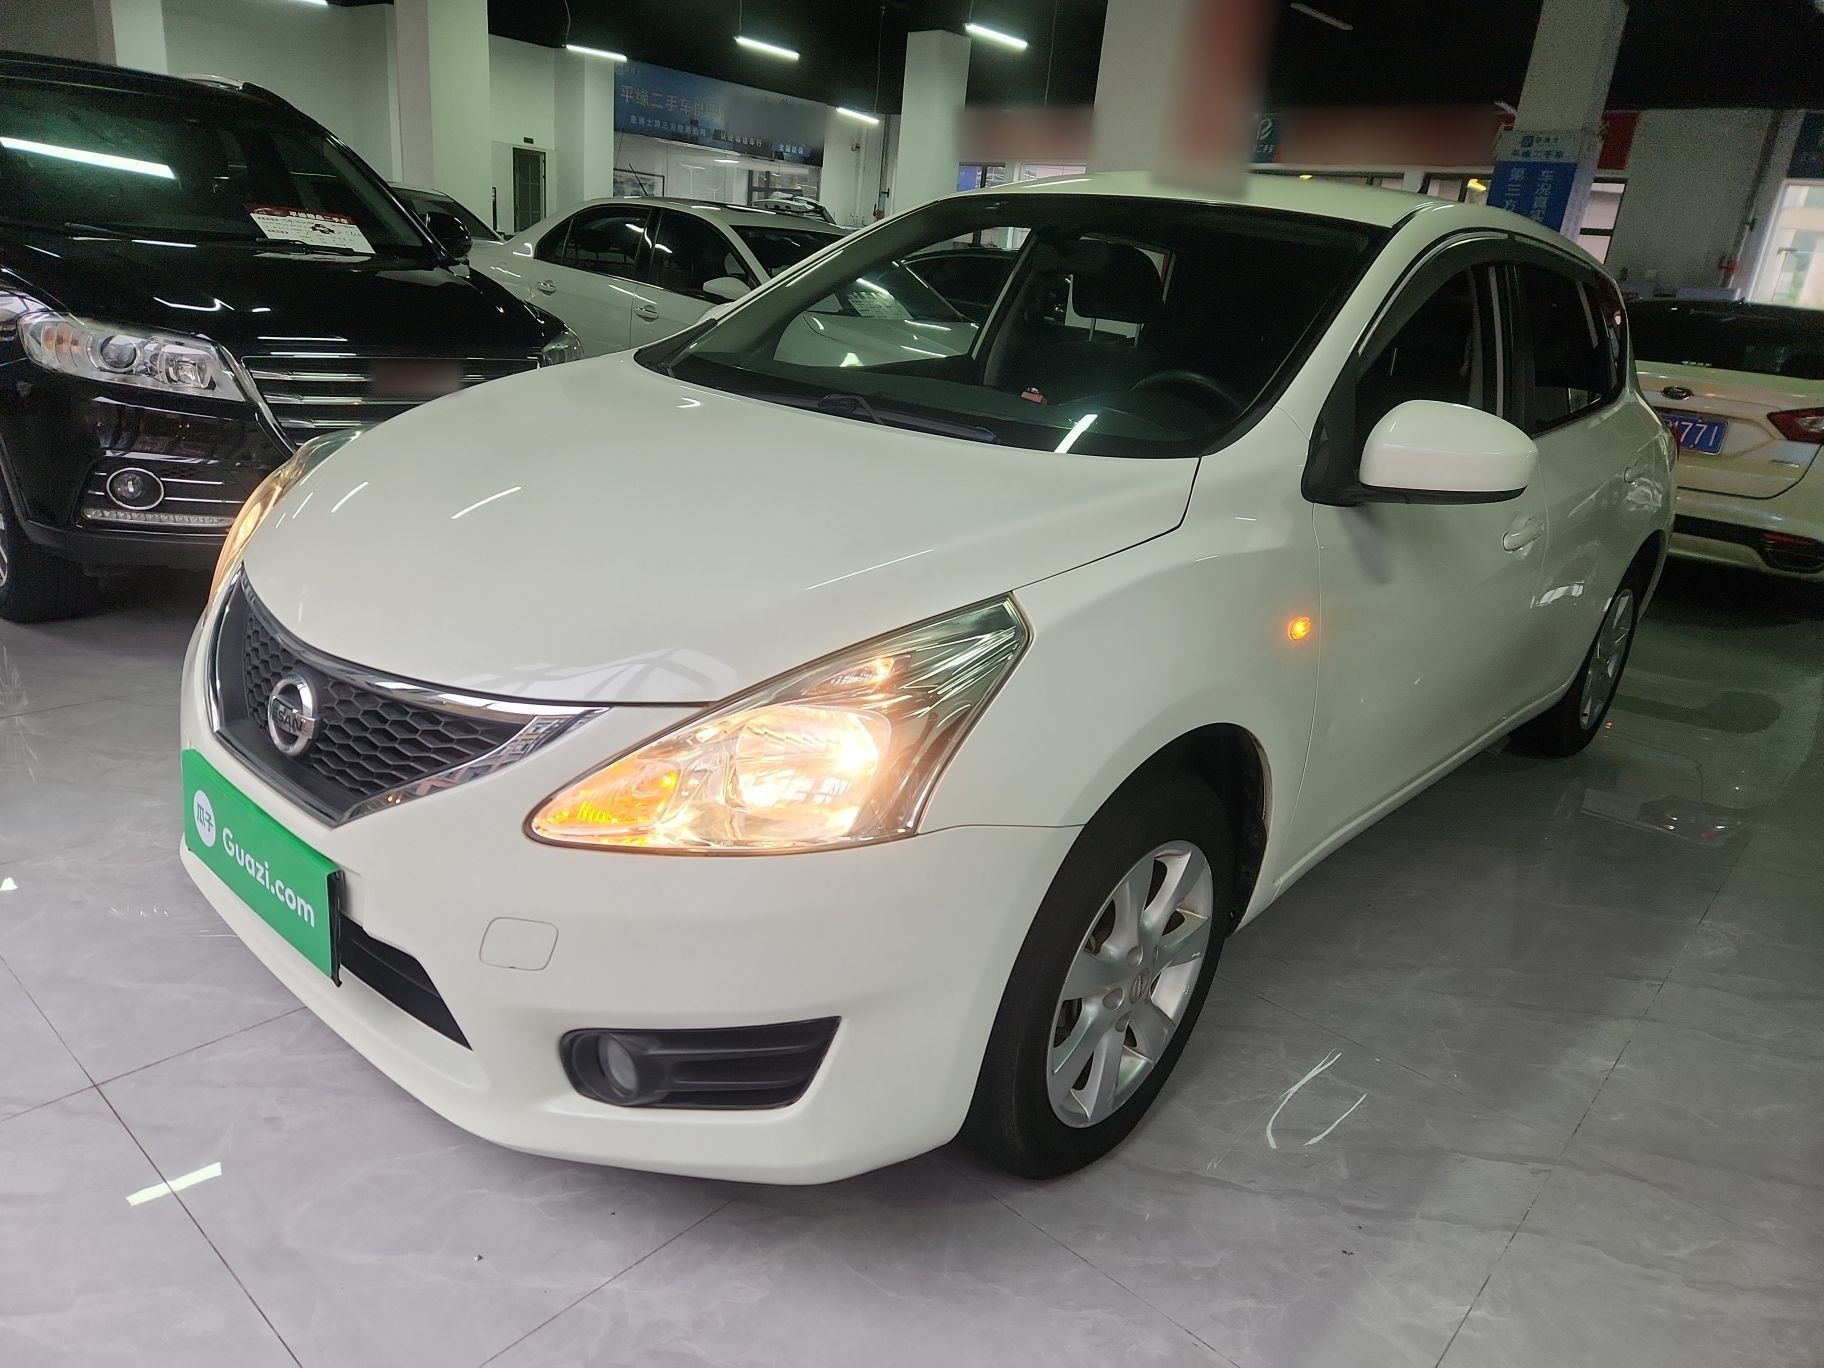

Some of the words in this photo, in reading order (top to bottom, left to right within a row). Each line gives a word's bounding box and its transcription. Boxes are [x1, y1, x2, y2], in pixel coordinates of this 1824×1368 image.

[1669, 420, 1719, 447] 771
[196, 803, 214, 833] 瓜子
[222, 827, 316, 928] Guazi.com
